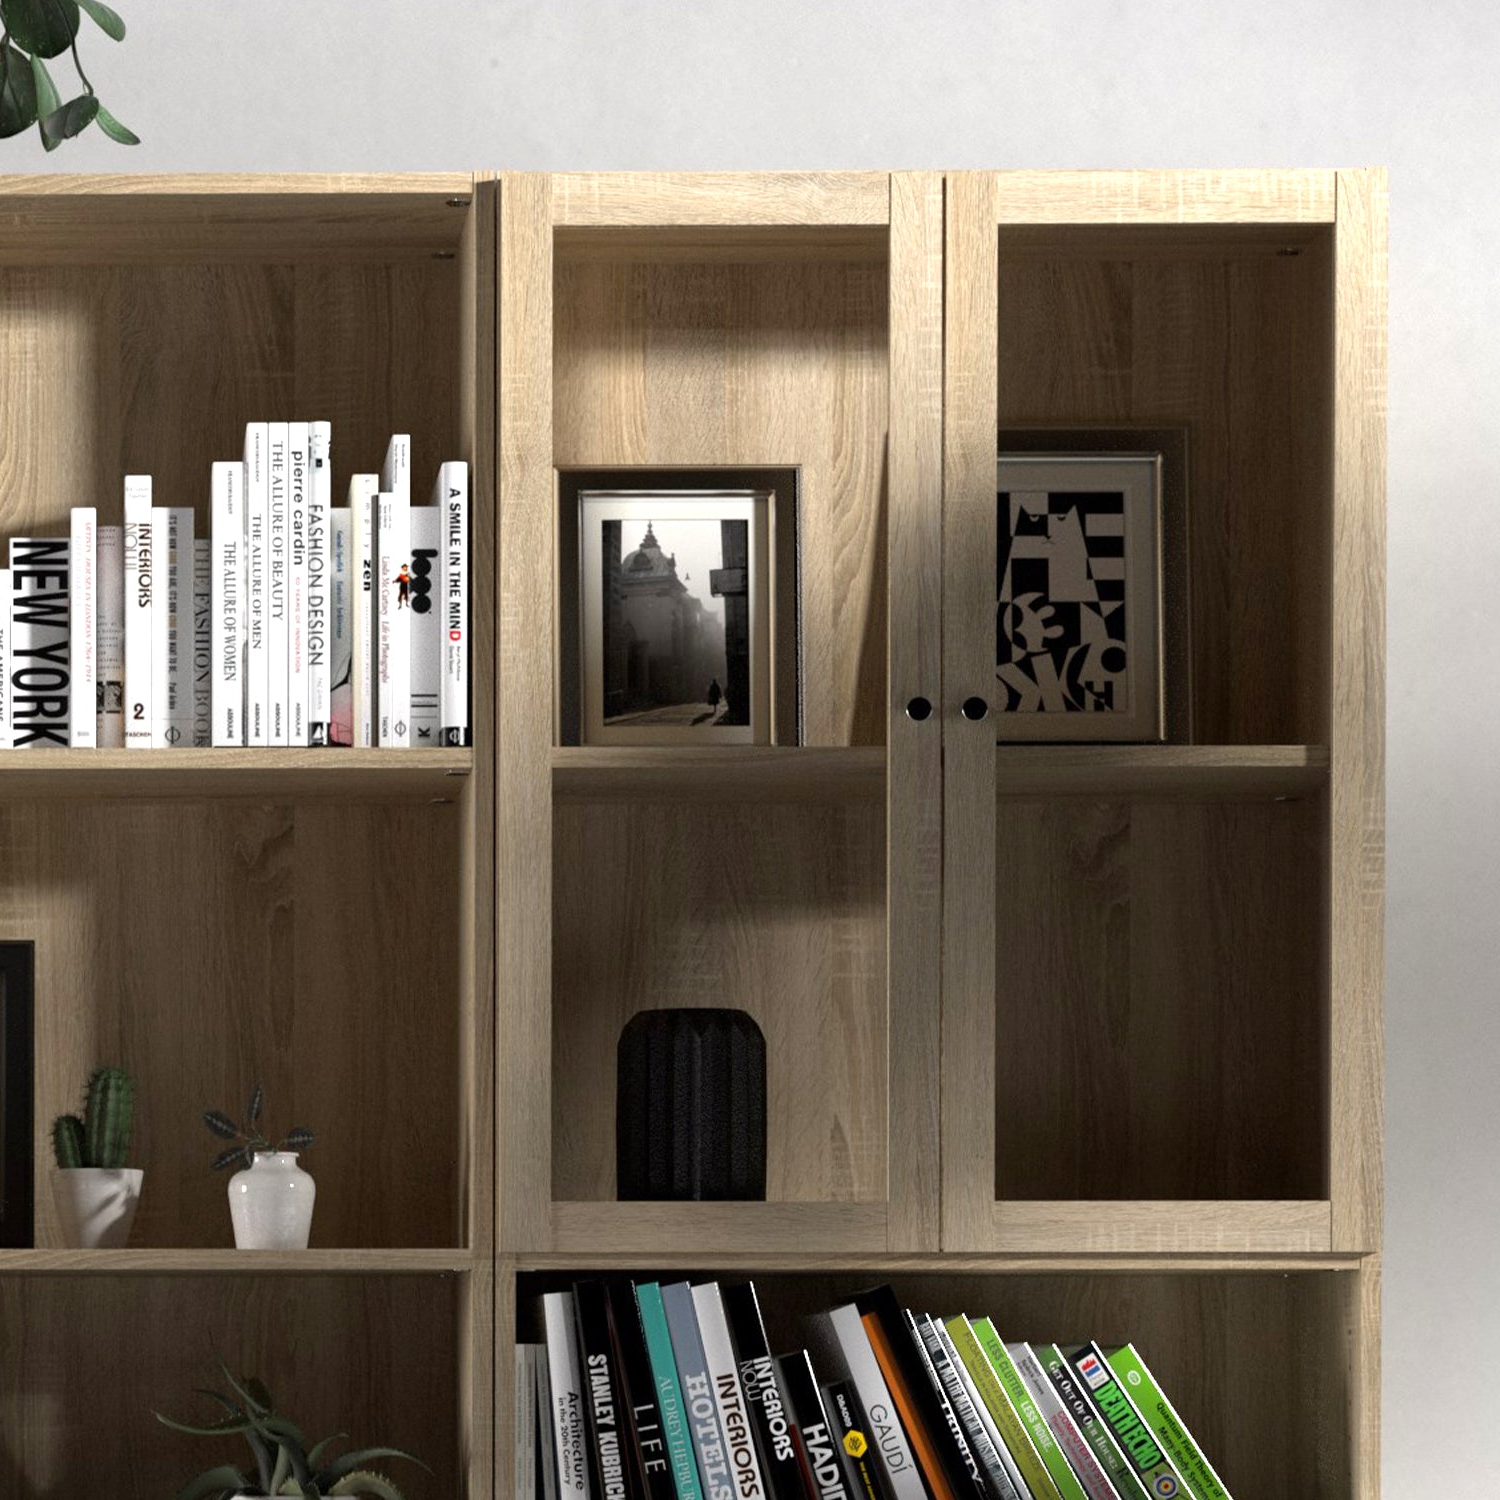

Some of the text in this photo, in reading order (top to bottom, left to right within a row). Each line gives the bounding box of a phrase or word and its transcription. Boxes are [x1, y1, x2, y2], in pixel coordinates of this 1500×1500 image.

[272, 441, 283, 621] THE ALLURE OF BEAUTY
[291, 451, 306, 565] pierre cardin
[138, 523, 152, 608] INTERIORS
[252, 514, 262, 649] THE ALLURE OF MEN
[308, 504, 323, 666] FASHION DESIGN
[449, 488, 461, 641] A SMILE IN THE MIND
[11, 542, 70, 746] NEW YORK
[195, 592, 209, 683] FASHION
[223, 542, 237, 681] THE ALLURE OF WOMEN
[133, 703, 145, 719] 2
[194, 689, 209, 747] BOOK
[588, 1353, 616, 1428] STANLEY
[659, 1376, 682, 1439] AUDREY
[740, 1360, 760, 1401] NOW
[753, 1357, 794, 1461] INTERIORS
[986, 1339, 1003, 1361] LESS
[997, 1361, 1026, 1401] CLUTTER.
[1020, 1401, 1038, 1423] LESS
[1033, 1423, 1054, 1452] NOISE.
[1048, 1360, 1065, 1379] GET
[1060, 1379, 1079, 1401] OUT
[1071, 1399, 1089, 1417] OF
[1083, 1415, 1100, 1435] OUR
[558, 1397, 573, 1486] in the 20th Century
[567, 1391, 587, 1491] Architecture
[633, 1404, 666, 1474] LIFE
[717, 1375, 759, 1497] INTERIORS
[868, 1403, 911, 1473] GAUDÍ
[939, 1402, 984, 1485] TRINITY
[1057, 1411, 1088, 1456] COMPUTER
[1094, 1382, 1162, 1470] DEATH ECHO
[1155, 1403, 1224, 1499] Quantum Field Theory of
[1157, 1427, 1190, 1471] Many-Body
